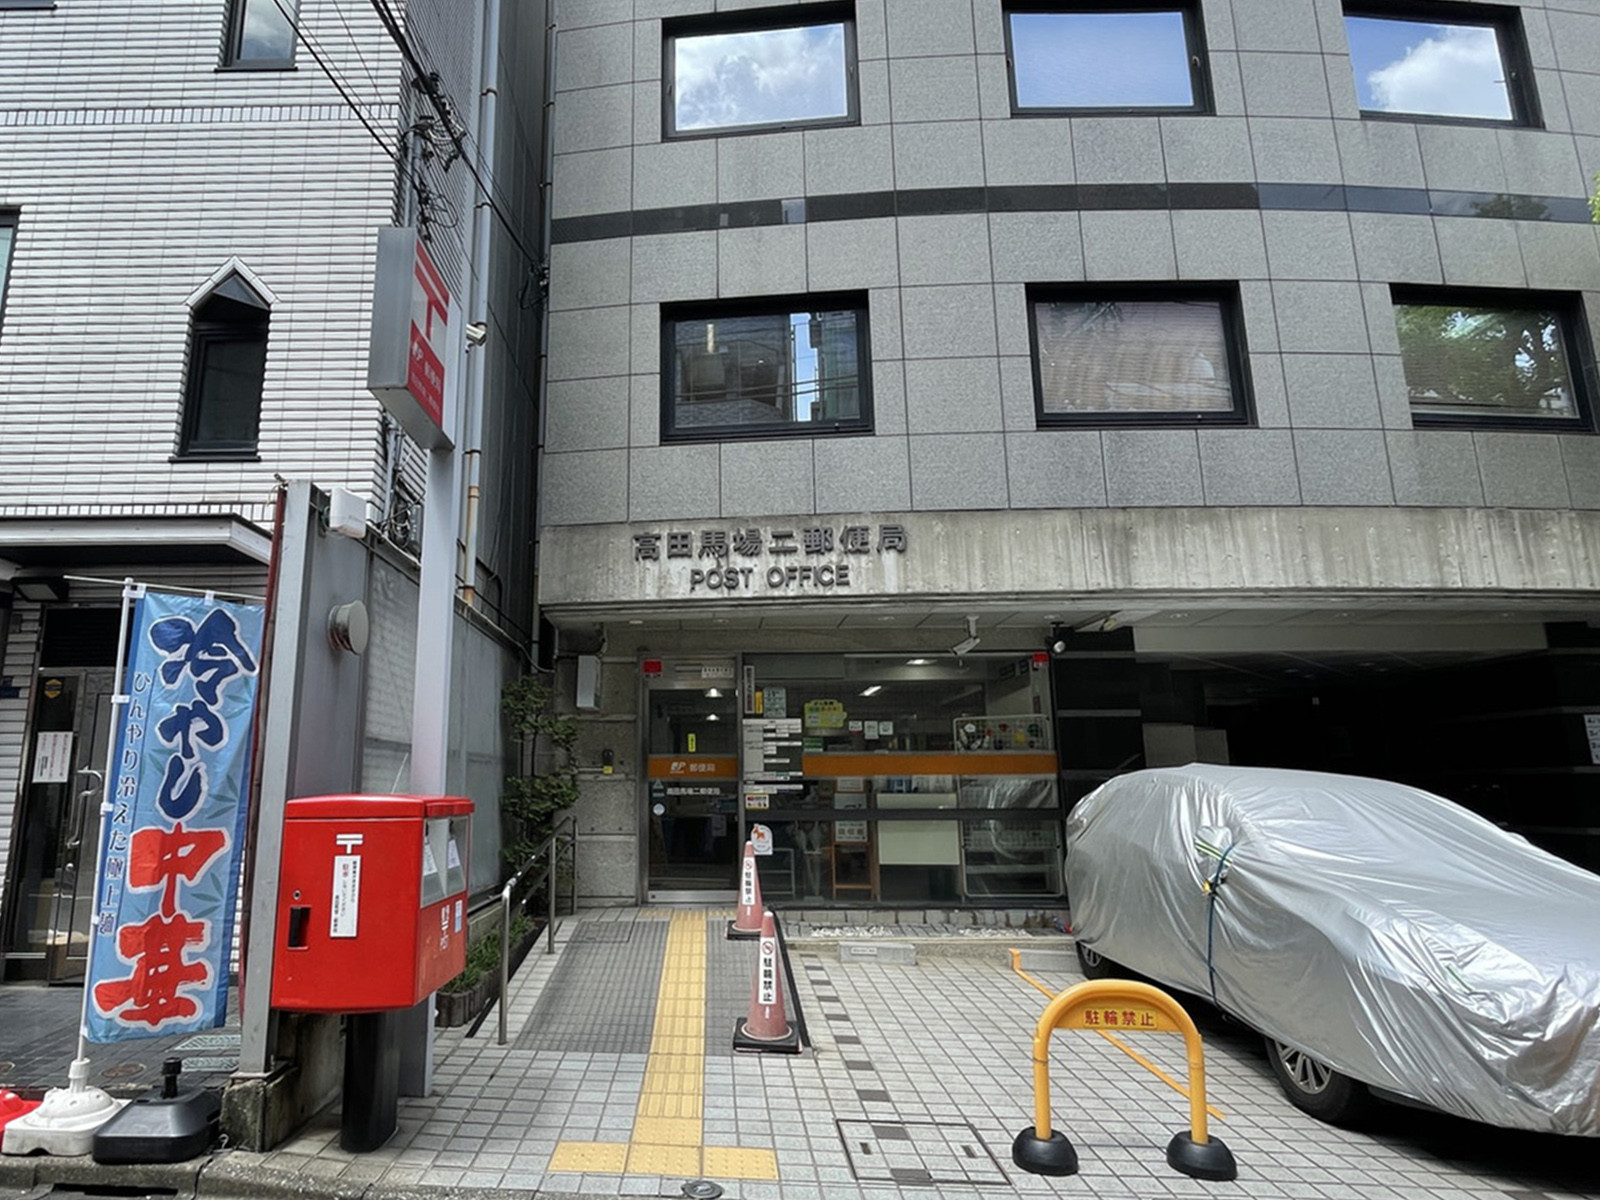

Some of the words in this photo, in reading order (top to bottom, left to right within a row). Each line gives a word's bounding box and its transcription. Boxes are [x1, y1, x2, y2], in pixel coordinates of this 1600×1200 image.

[633, 524, 907, 561] 高田馬場二郵便局
[690, 568, 753, 590] POST
[767, 565, 850, 588] OFFICE
[94, 608, 258, 1028] 冷やし中華
[1085, 1010, 1154, 1026] 駐輪禁止
